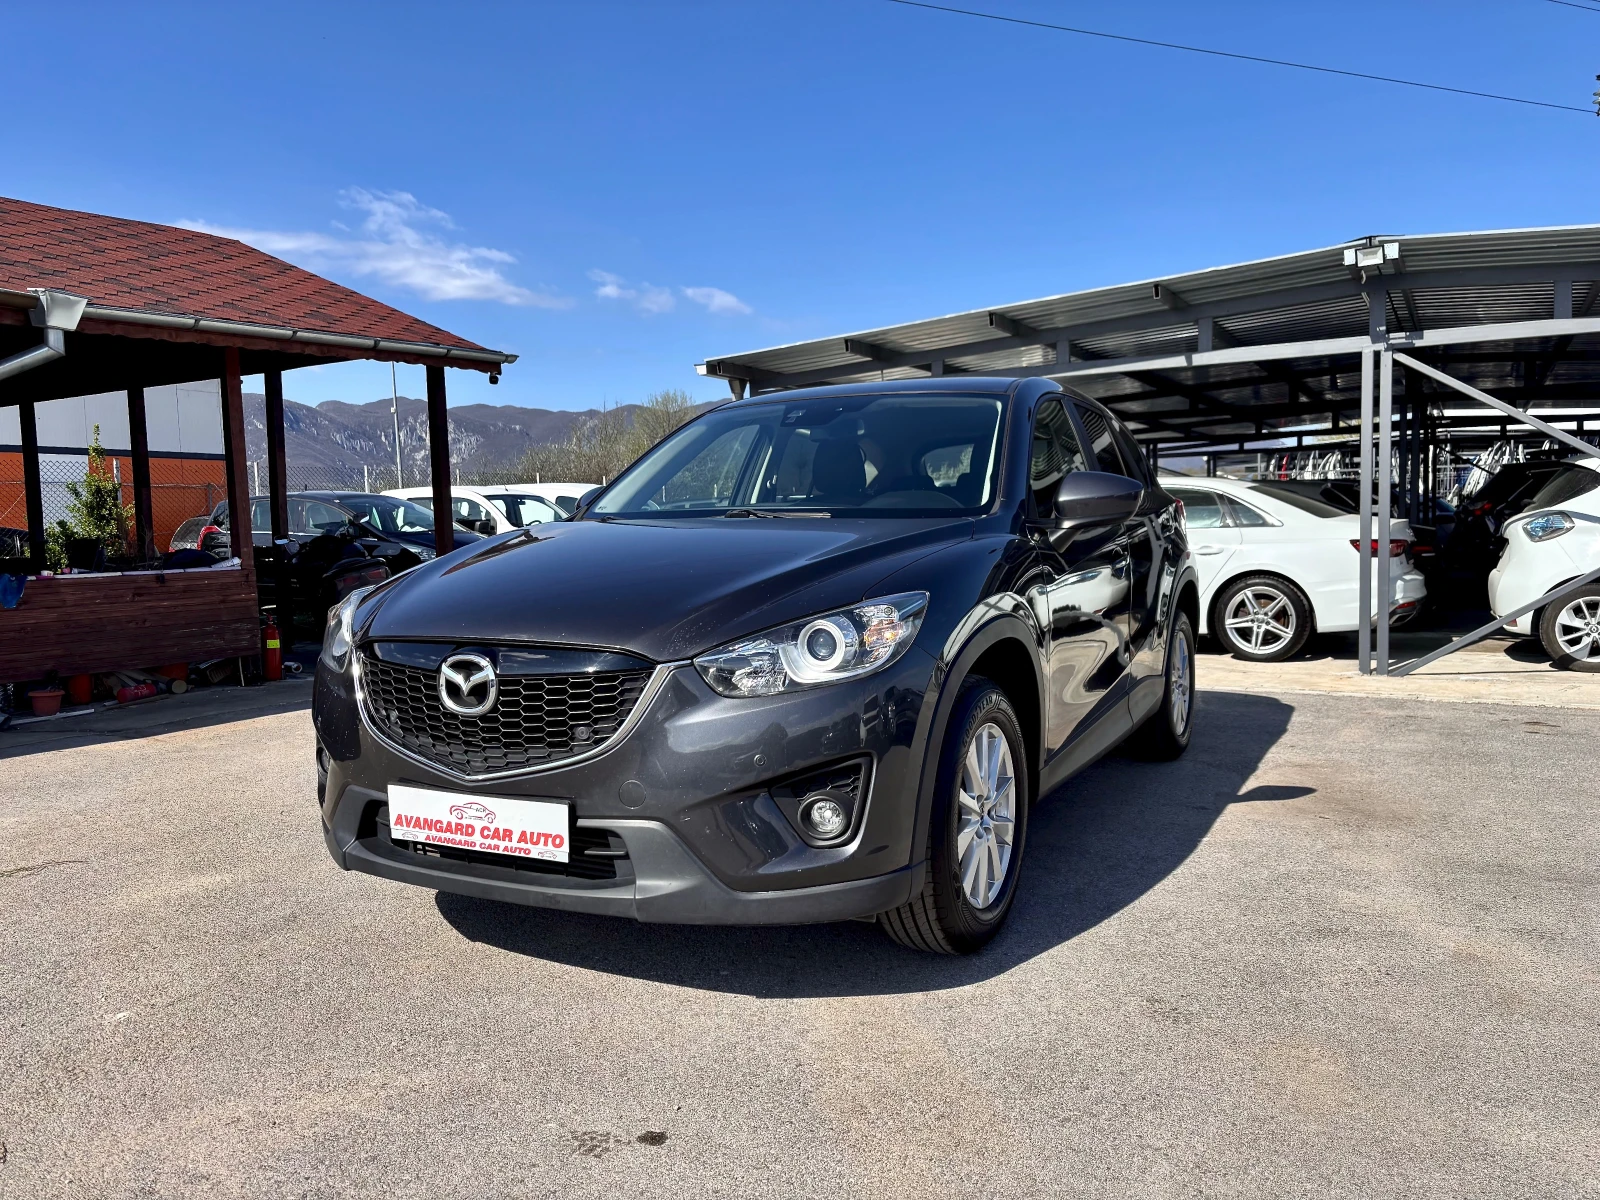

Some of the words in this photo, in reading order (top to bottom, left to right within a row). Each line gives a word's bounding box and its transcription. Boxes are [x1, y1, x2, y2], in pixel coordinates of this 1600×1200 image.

[394, 813, 476, 837] AVANGARD
[479, 825, 513, 842] CAR
[516, 830, 565, 849] AUTO
[424, 834, 477, 848] AVANGARD
[479, 842, 501, 852] CAR
[502, 845, 532, 856] AUTO
